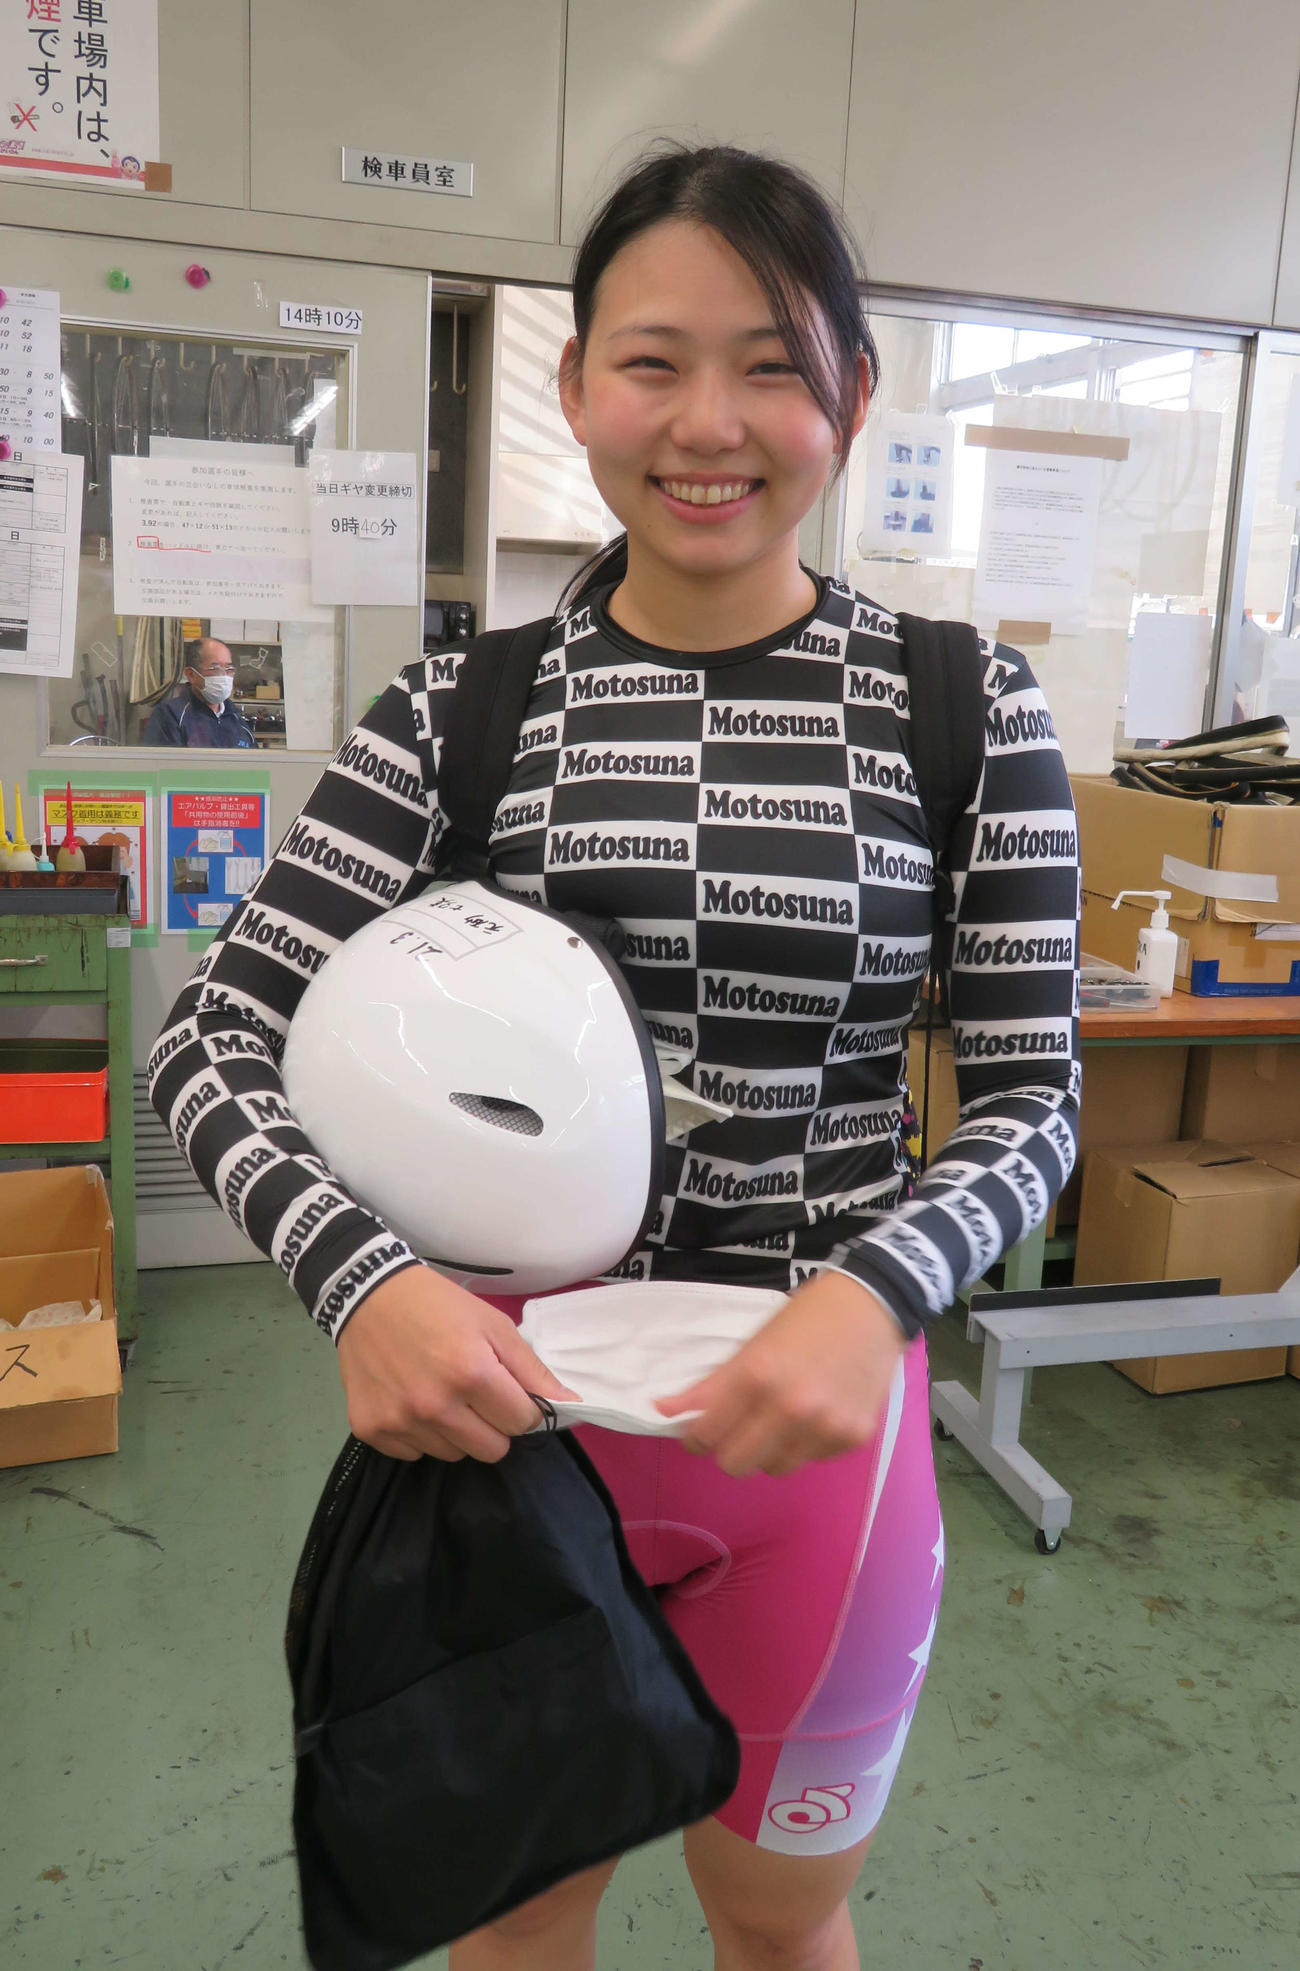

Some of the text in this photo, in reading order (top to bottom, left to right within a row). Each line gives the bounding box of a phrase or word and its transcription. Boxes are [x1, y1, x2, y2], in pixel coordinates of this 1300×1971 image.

[362, 156, 455, 188] 検車員室
[285, 308, 363, 330] 14時10分
[316, 483, 412, 498] 当日ギヤ変更締切
[331, 516, 397, 536] 9時40分
[570, 672, 699, 702] Motosuna
[708, 706, 840, 738] Motosuna
[332, 733, 428, 809] Motosuna
[561, 749, 694, 779] Motosuna
[704, 790, 847, 826] Motosuna
[548, 831, 690, 866] Motosuna
[976, 821, 1076, 863] Motosuna
[282, 822, 401, 903] Motosuna
[703, 879, 854, 926] Motosuna
[625, 932, 691, 962] suna
[955, 931, 1072, 966] Motosuna
[703, 975, 841, 1018] Motosuna
[699, 1070, 817, 1111] Motosuna
[810, 1108, 901, 1146] Motosuna
[683, 1158, 799, 1202] Motosuna
